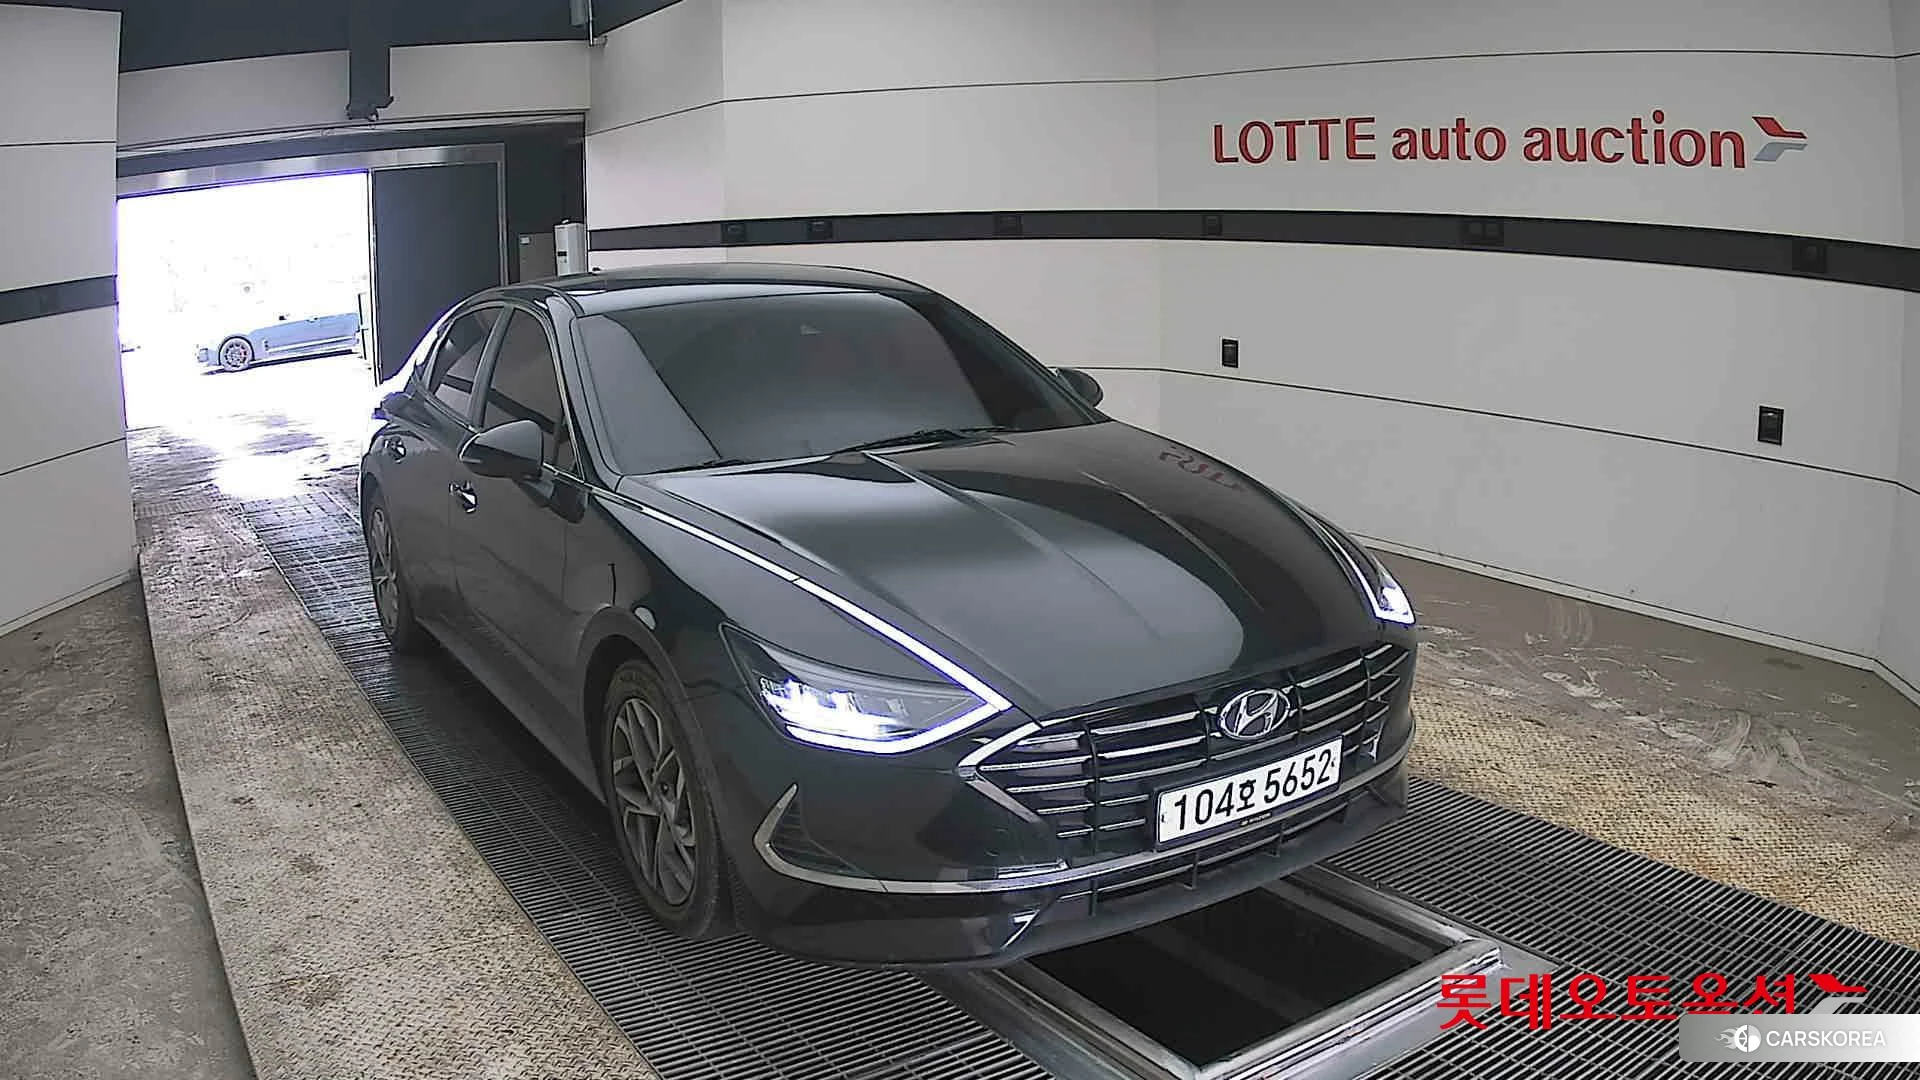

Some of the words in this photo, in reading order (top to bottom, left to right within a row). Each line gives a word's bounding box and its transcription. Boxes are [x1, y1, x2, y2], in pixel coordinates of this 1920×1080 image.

[1212, 116, 1377, 164] LOTTE
[1391, 116, 1507, 162] auto
[1522, 109, 1746, 169] auction
[1174, 778, 1257, 831] 104호
[1263, 748, 1332, 804] 5652
